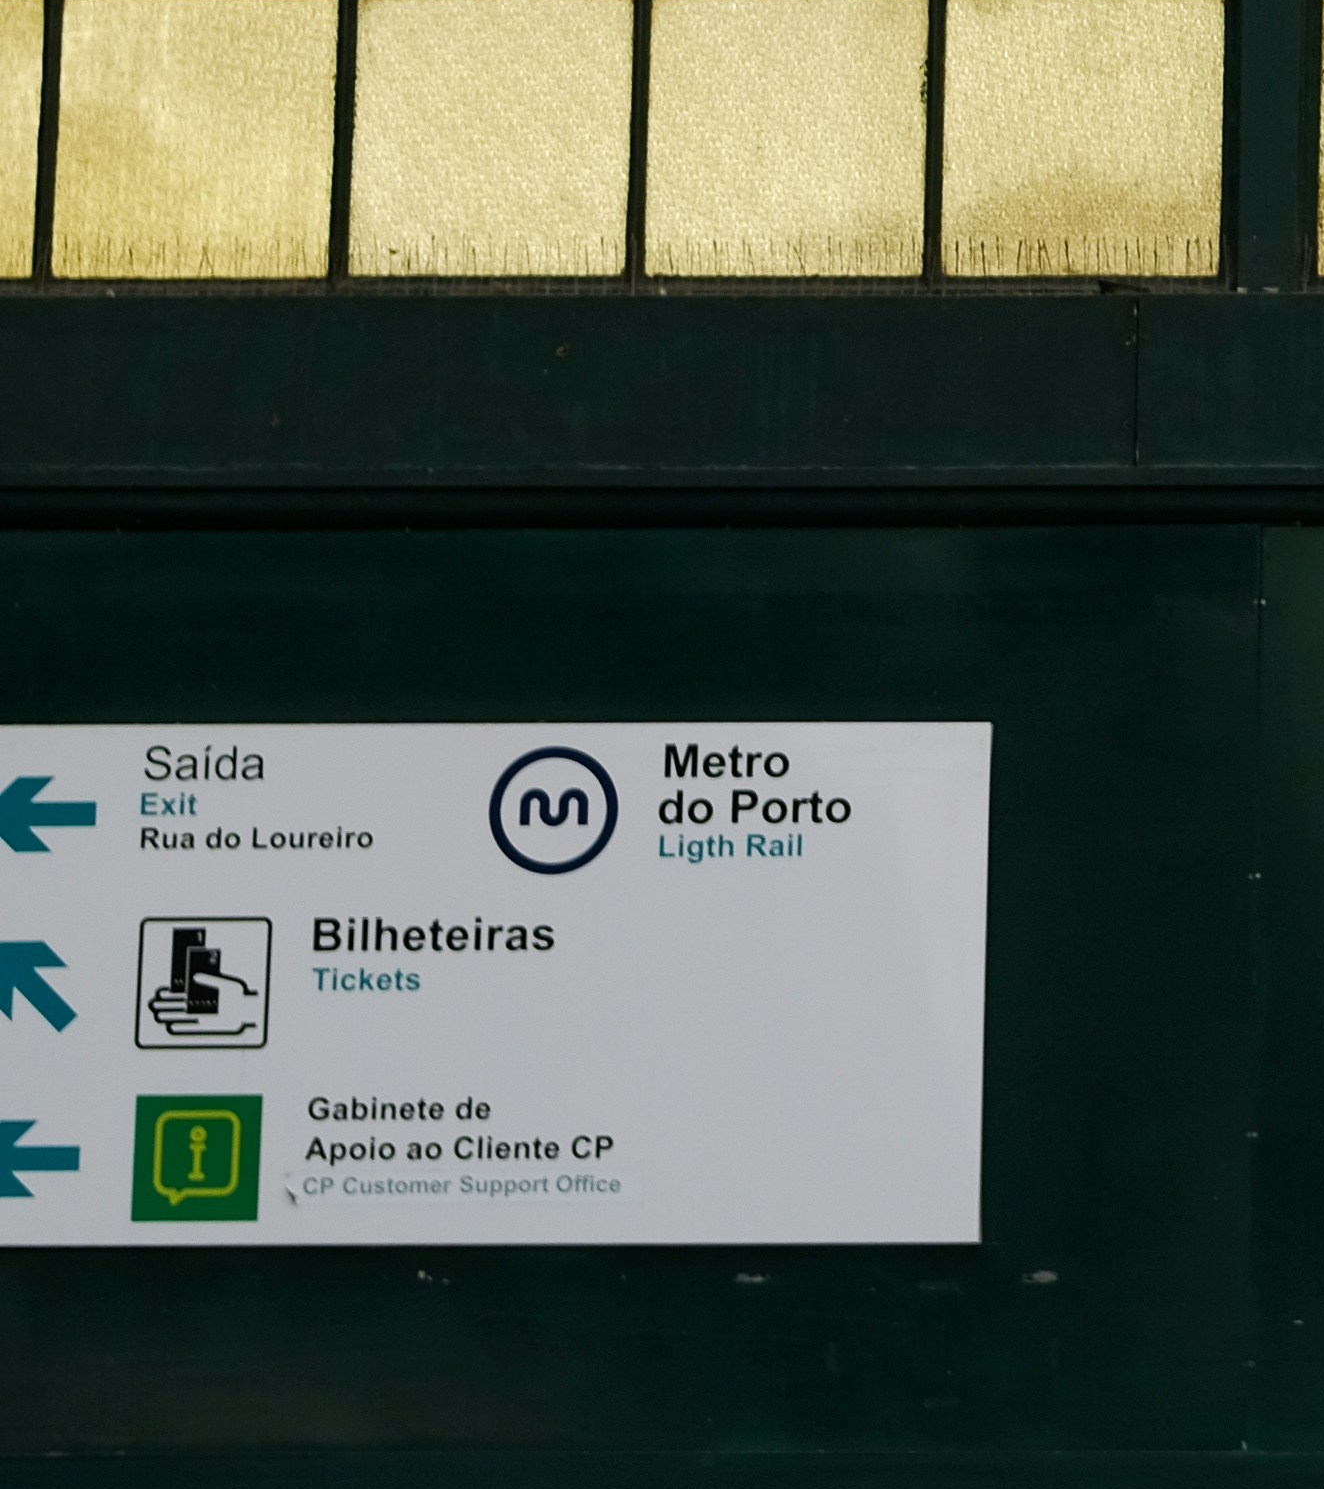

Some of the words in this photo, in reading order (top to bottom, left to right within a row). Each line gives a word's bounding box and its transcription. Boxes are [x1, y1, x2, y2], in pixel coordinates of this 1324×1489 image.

[145, 745, 263, 781] Saída
[665, 744, 789, 778] Metro
[141, 792, 196, 816] Exit
[659, 790, 713, 824] do
[731, 790, 851, 824] Porto
[141, 827, 194, 849] Rua
[206, 827, 240, 849] do
[252, 826, 373, 849] Loureiro
[659, 834, 734, 863] Ligth
[747, 834, 802, 857] Rail
[313, 917, 554, 951] Bilheteiras
[313, 968, 420, 991] Tickets
[308, 1097, 444, 1121] Gabinete
[456, 1096, 491, 1120] de
[305, 1137, 395, 1166] Apoio
[407, 1142, 442, 1160] ao
[454, 1136, 559, 1160] Cliente
[572, 1135, 613, 1159] CP
[303, 1177, 334, 1195] CP
[342, 1176, 451, 1195] Customer
[460, 1175, 548, 1198] Support
[556, 1175, 621, 1193] Office
